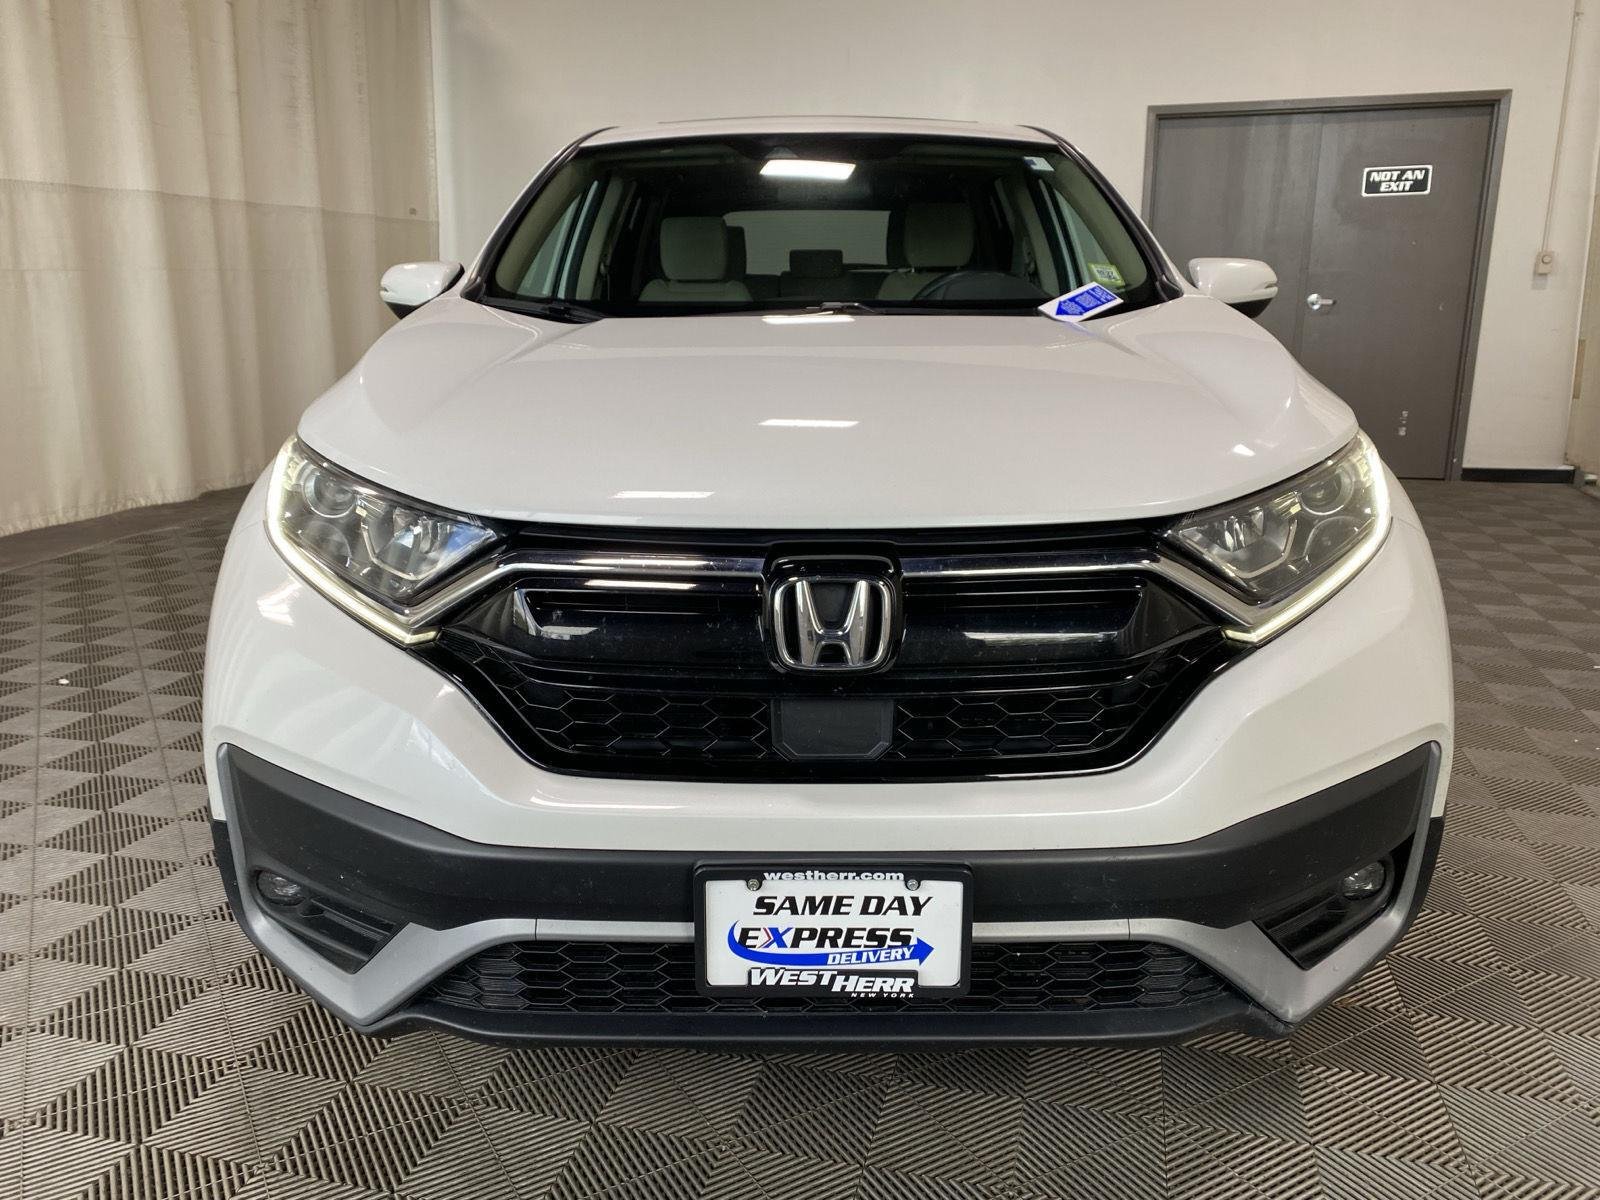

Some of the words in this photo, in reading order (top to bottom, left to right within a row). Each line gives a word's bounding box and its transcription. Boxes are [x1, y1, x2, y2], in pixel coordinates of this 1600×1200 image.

[1369, 171, 1401, 183] NOT
[1402, 170, 1425, 180] AN
[1380, 181, 1413, 192] EXIT
[763, 870, 905, 881] westherr.com
[753, 895, 855, 916] SAME
[859, 896, 934, 916] DAY
[738, 927, 914, 949] EXPRESS
[827, 947, 914, 965] DELIVERY
